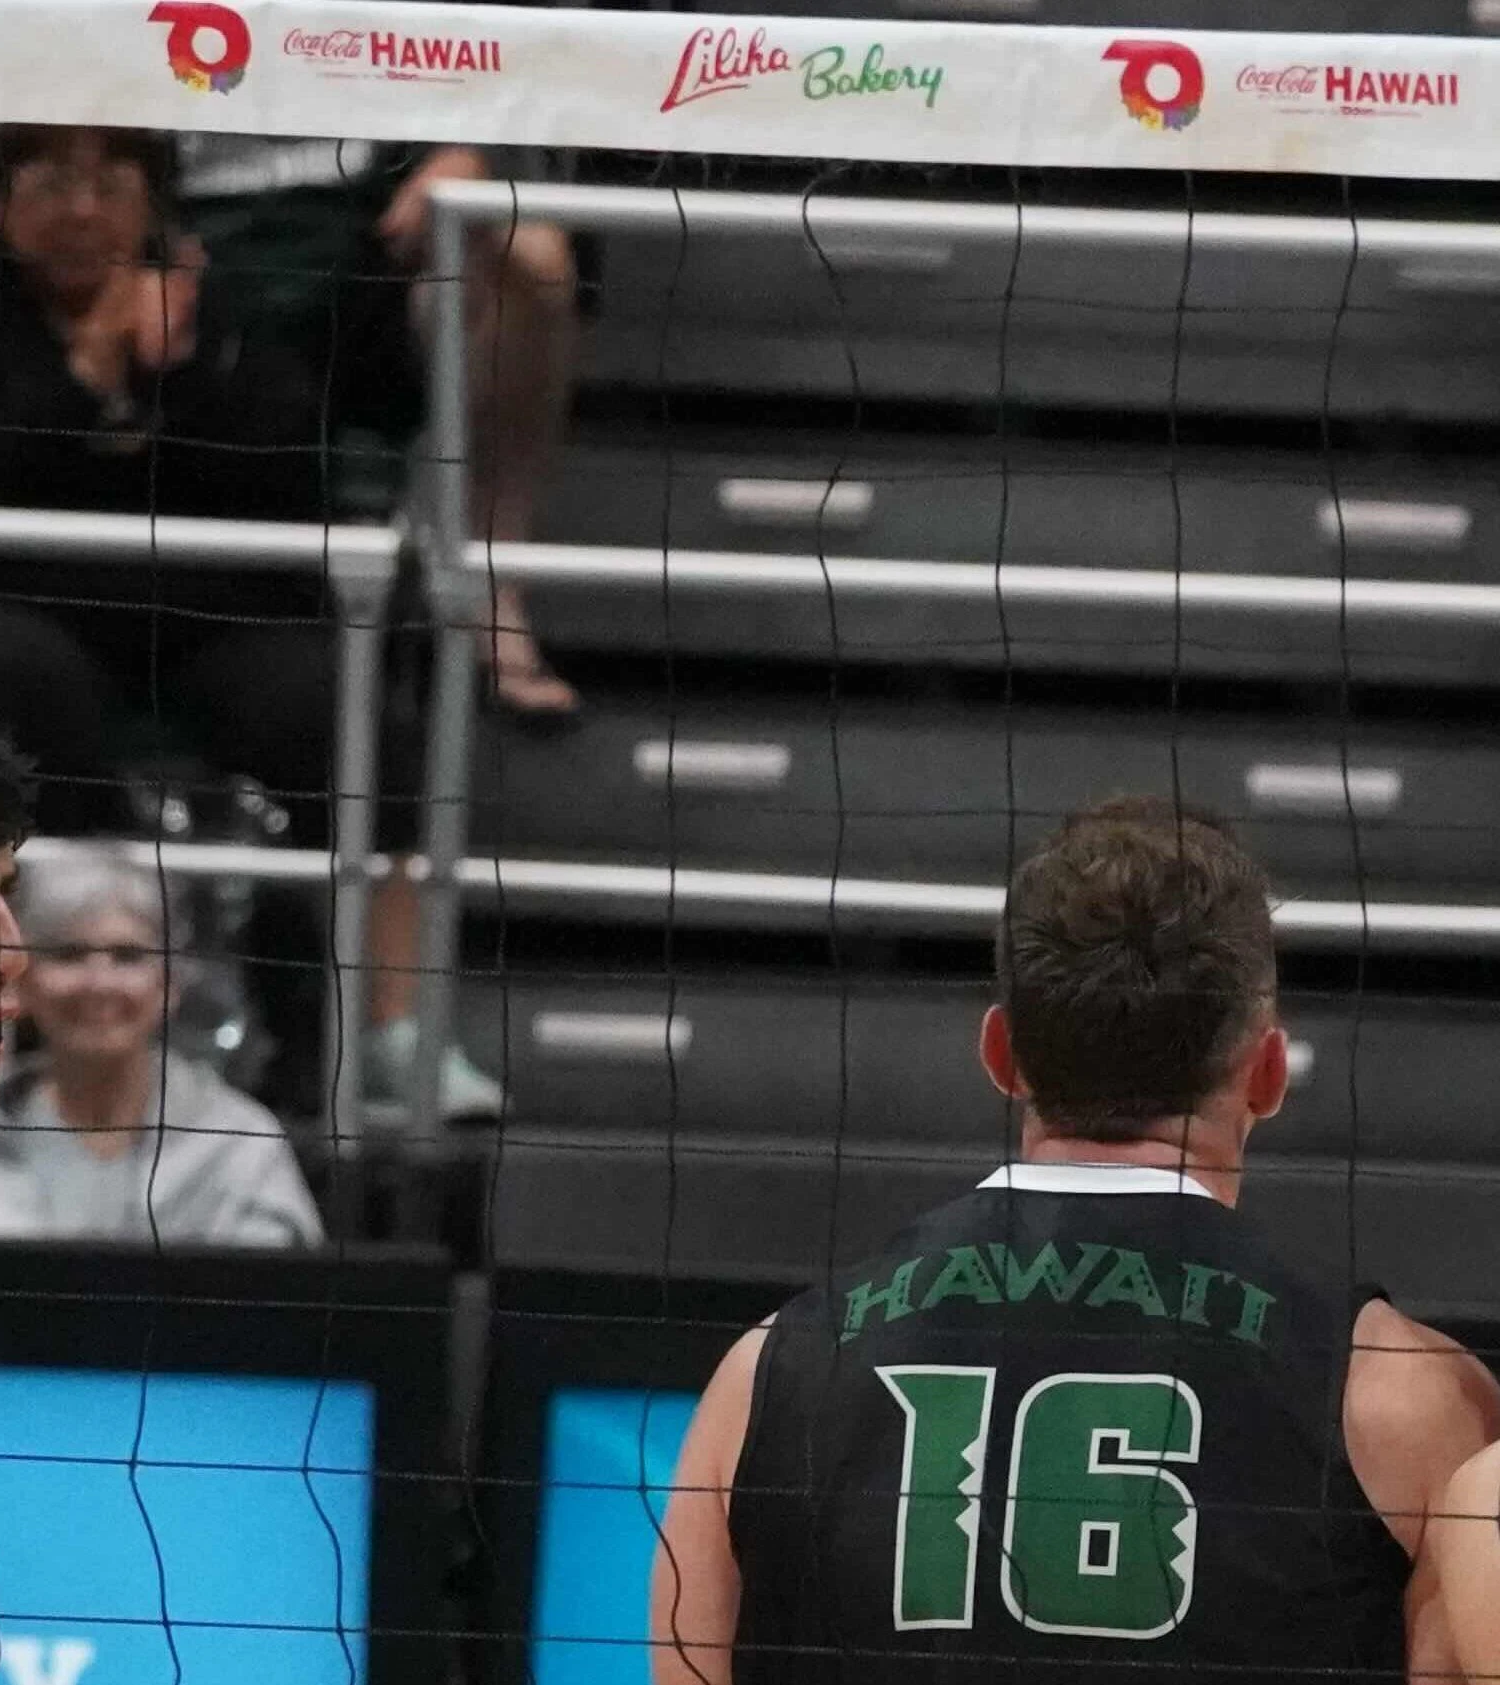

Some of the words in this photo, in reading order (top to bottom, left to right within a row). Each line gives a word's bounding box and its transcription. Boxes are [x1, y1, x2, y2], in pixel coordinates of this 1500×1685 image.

[370, 31, 500, 72] HAWAII
[799, 43, 943, 108] Bakery
[1325, 66, 1458, 105] HAWAII
[873, 1364, 1201, 1640] 16
